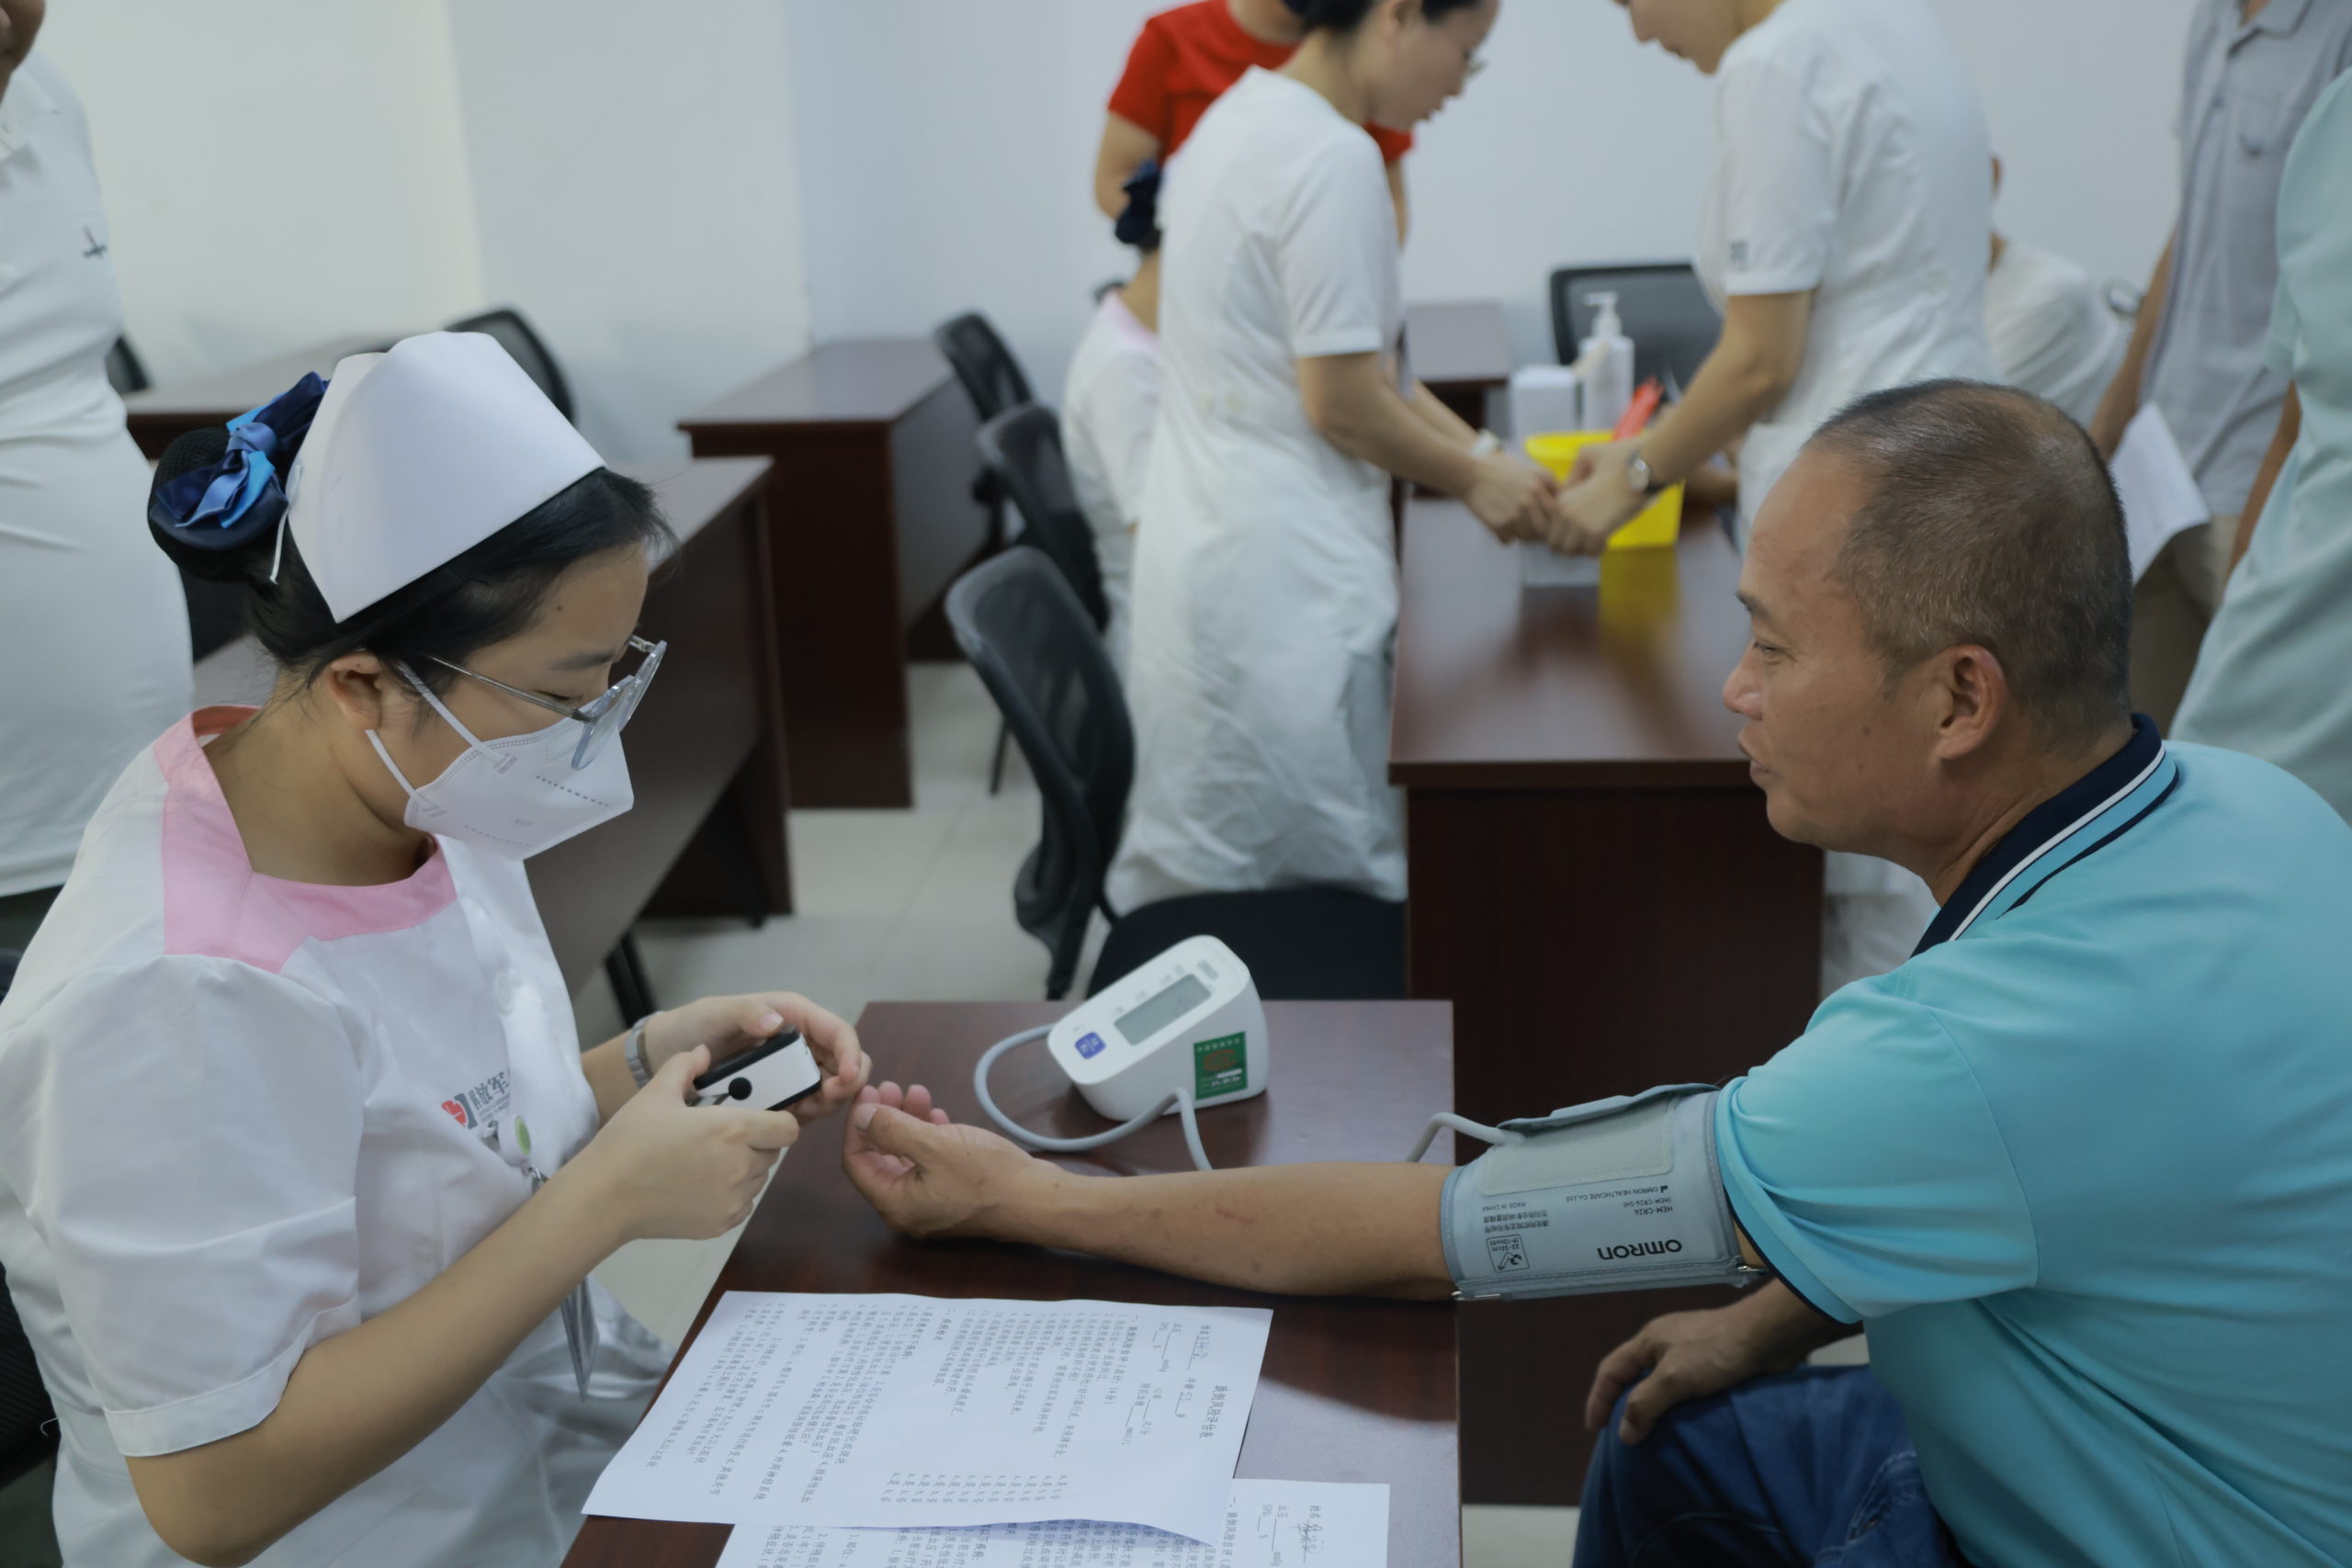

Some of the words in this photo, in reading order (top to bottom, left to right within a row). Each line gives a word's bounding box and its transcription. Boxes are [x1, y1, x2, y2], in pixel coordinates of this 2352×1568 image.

[468, 1068, 511, 1111] 解放军
[1589, 1190, 1632, 1200] HEALTHCARE
[1633, 1186, 1658, 1196] OMRON
[1634, 1205, 1673, 1216] HEM-CR24
[1597, 1239, 1683, 1260] OMRON
[1197, 1384, 1228, 1438] 跌倒风险评估表
